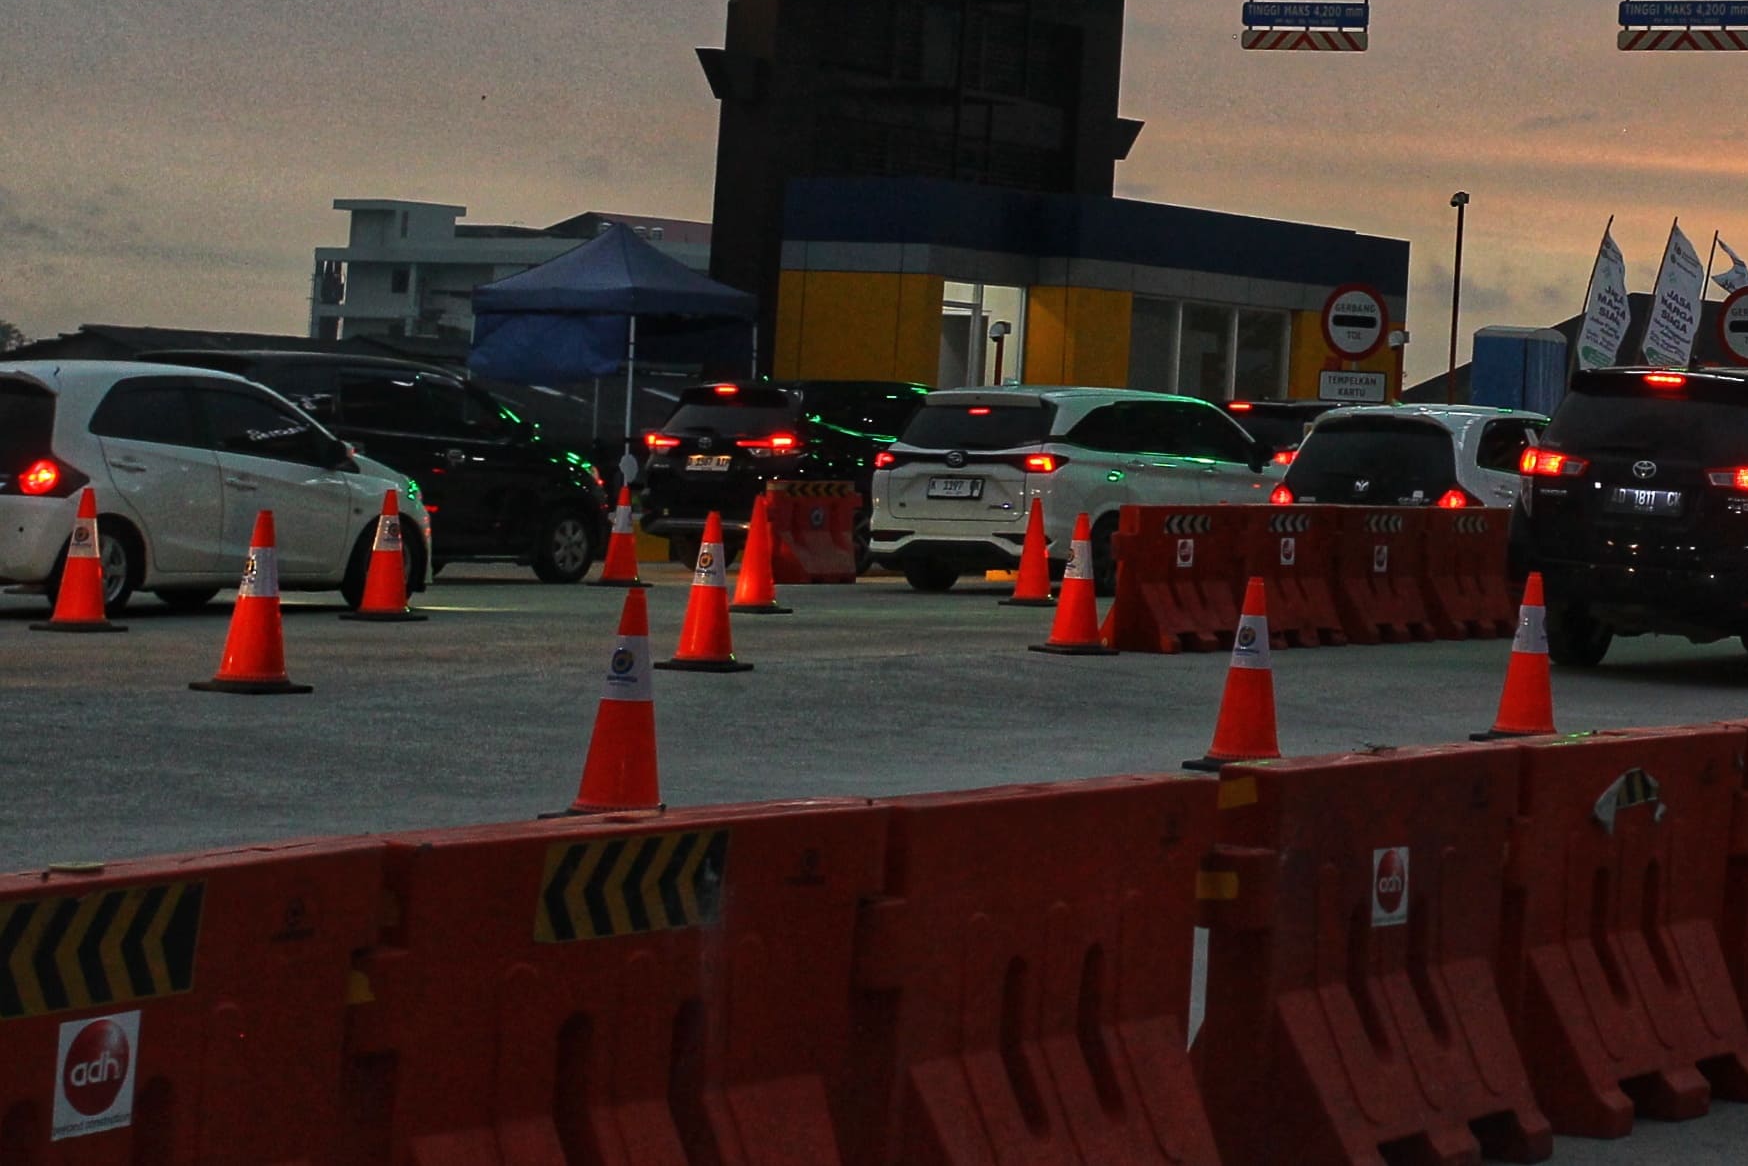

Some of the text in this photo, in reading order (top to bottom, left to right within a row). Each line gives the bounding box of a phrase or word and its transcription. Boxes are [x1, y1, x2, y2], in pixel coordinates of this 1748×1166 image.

[1248, 4, 1281, 16] TINGGI
[1283, 5, 1311, 17] MAKS
[1625, 3, 1660, 16] TINGGI
[1663, 4, 1692, 17] MAKS
[1328, 374, 1378, 386] TEMPELKAN
[1634, 489, 1656, 506] 1811
